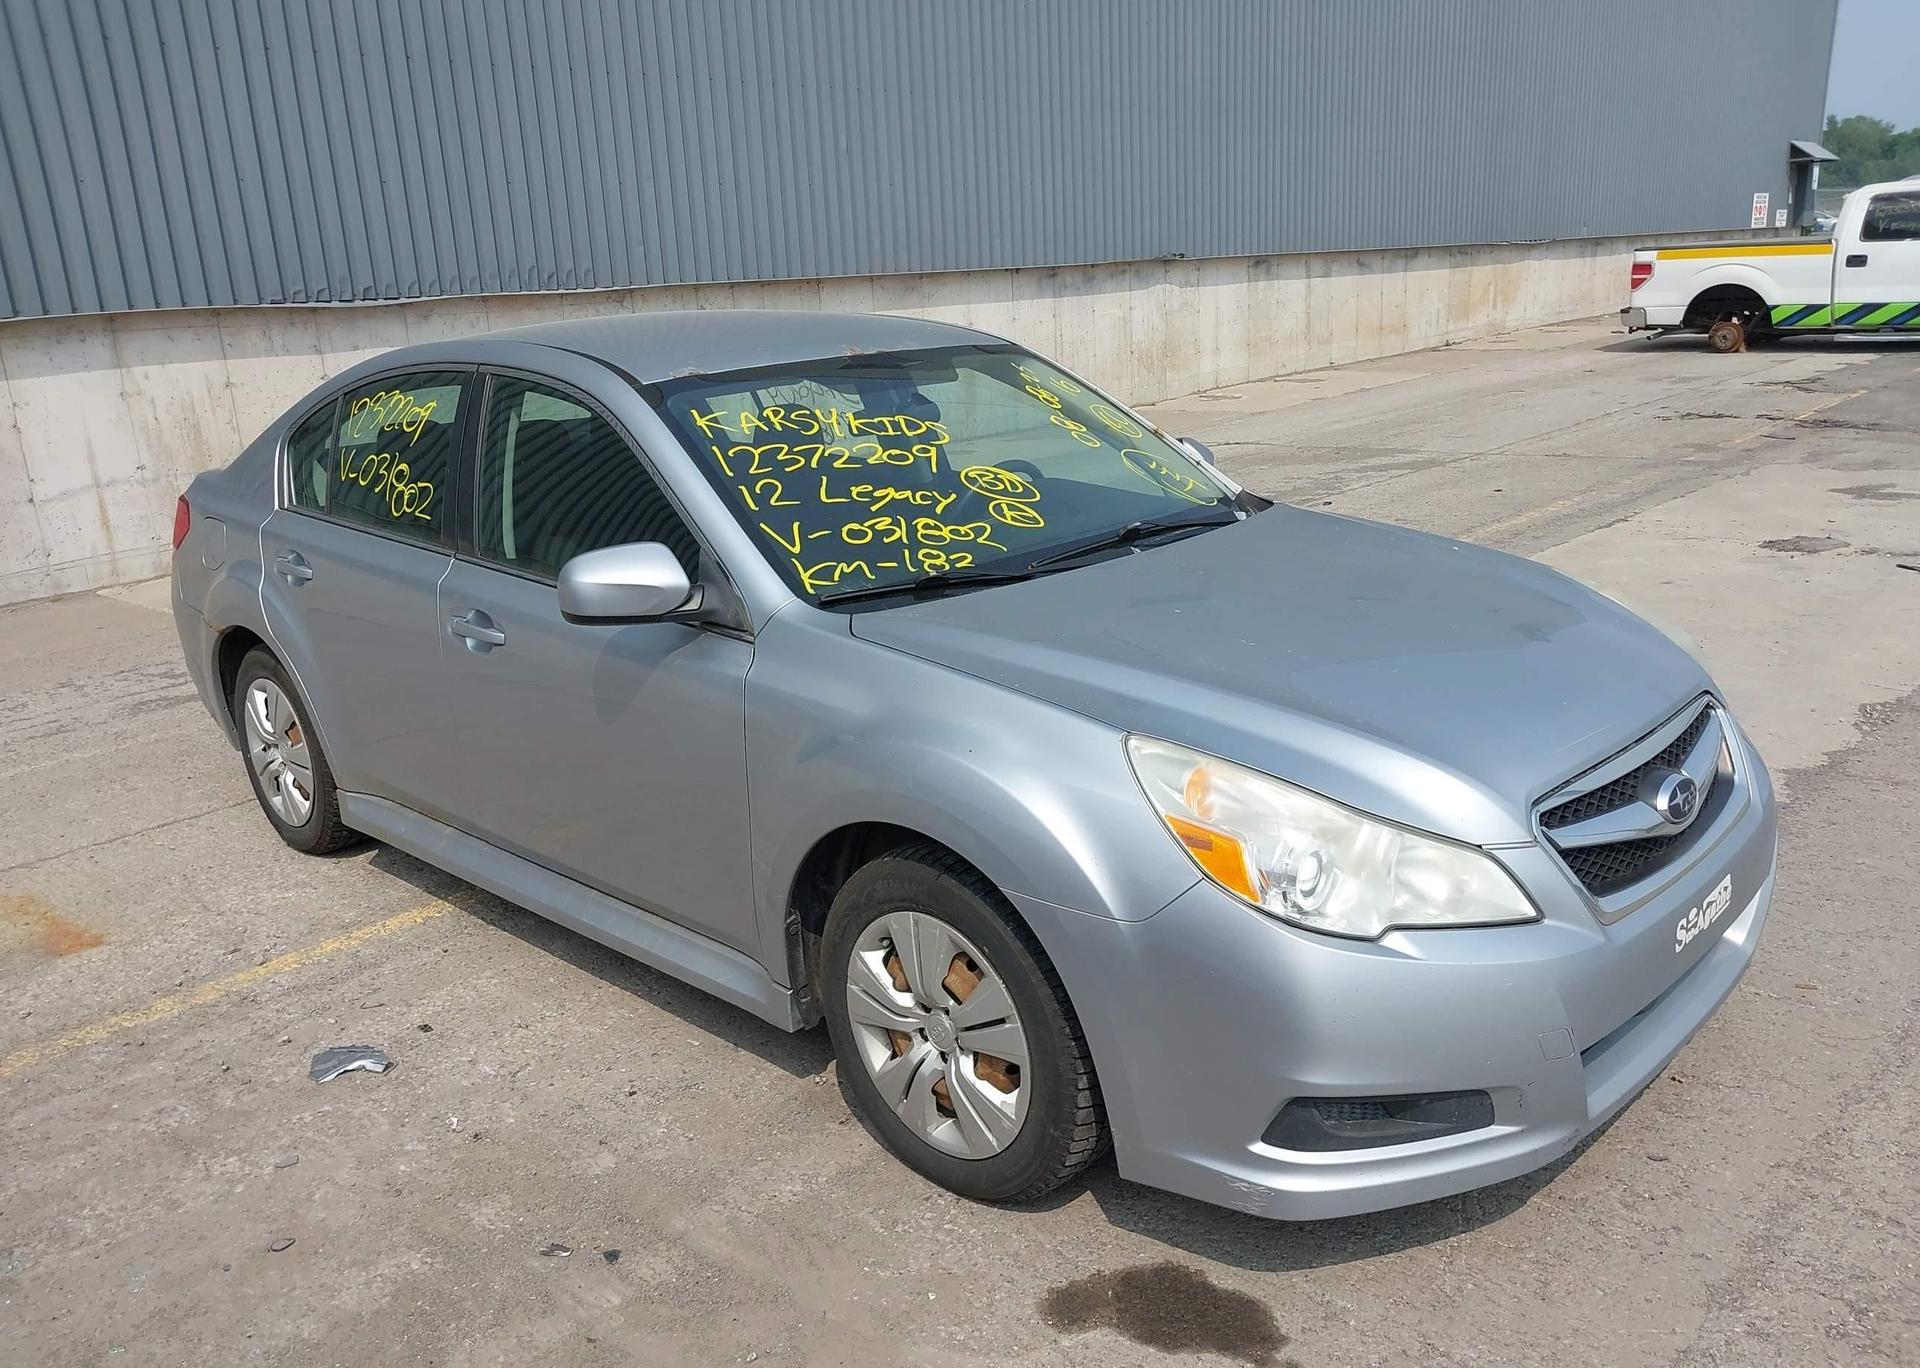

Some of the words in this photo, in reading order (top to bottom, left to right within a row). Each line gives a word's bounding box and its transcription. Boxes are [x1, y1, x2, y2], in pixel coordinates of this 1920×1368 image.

[347, 390, 437, 447] 12372209
[711, 442, 939, 478] 12372209
[738, 478, 801, 511] 12
[819, 475, 957, 514] Legacy
[759, 516, 1008, 554] V-031802
[791, 548, 976, 595] KM-182
